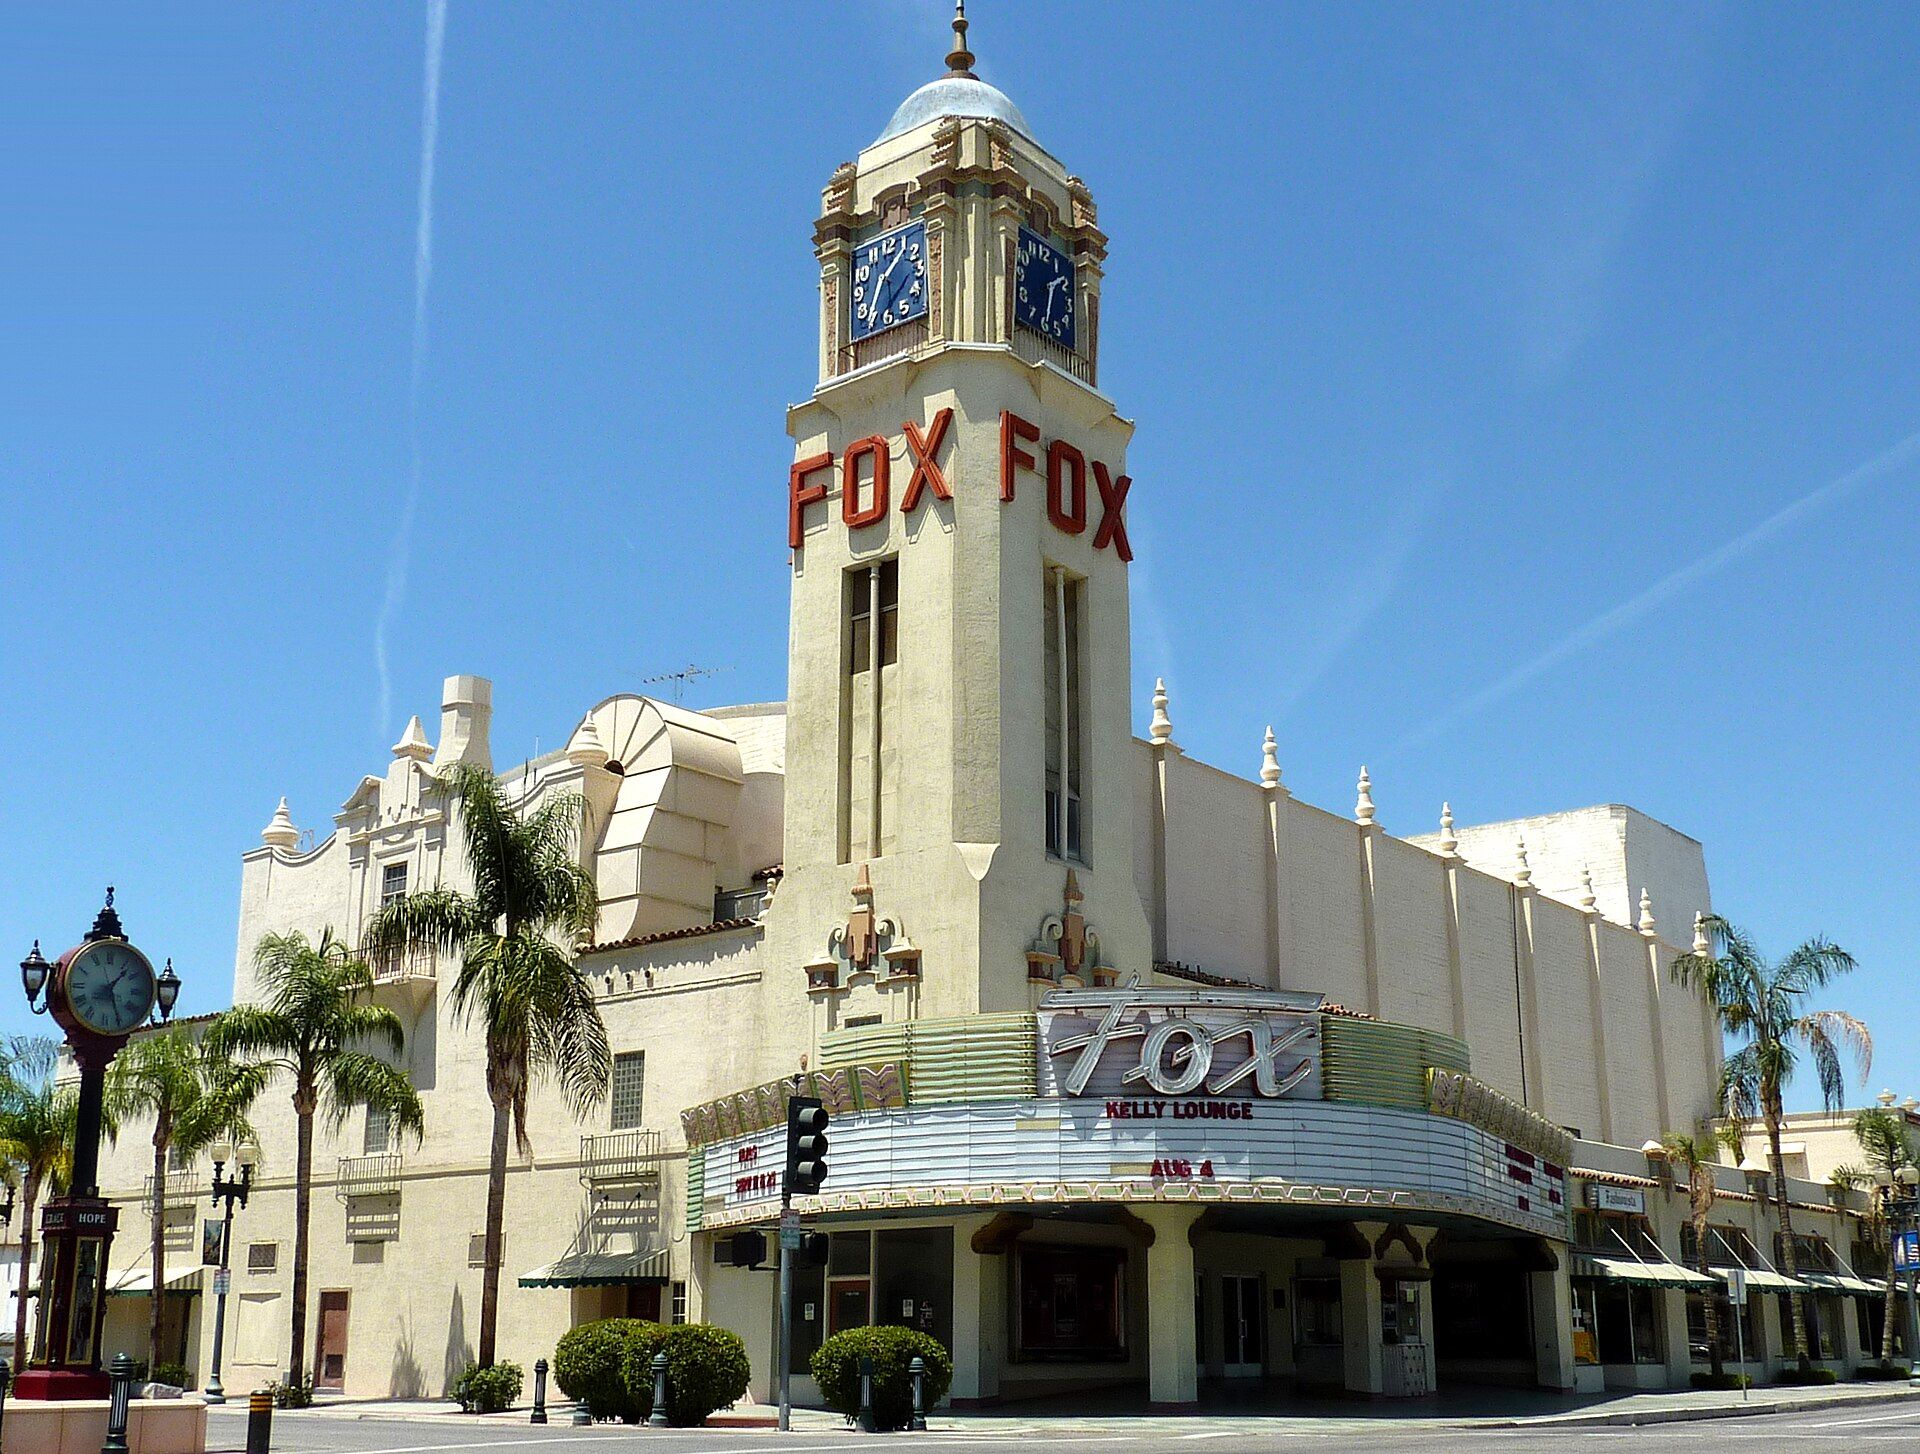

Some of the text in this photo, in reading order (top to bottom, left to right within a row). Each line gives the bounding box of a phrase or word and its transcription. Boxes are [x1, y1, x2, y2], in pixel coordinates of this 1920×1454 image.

[882, 237, 895, 255] 12
[910, 243, 919, 261] 2
[1028, 240, 1036, 257] 11
[1039, 243, 1050, 262] 12
[869, 247, 878, 263] 11
[1018, 247, 1030, 266] 10
[915, 260, 924, 277] 3
[1017, 266, 1025, 281] 9
[1054, 258, 1059, 273] 1
[855, 265, 870, 284] 10
[909, 281, 921, 297] 4
[1062, 278, 1069, 292] 2
[854, 286, 864, 302] 9
[1019, 286, 1028, 303] 8
[857, 303, 868, 319] 8
[899, 299, 910, 315] 5
[1029, 305, 1036, 319] 7
[1065, 296, 1072, 313] 3
[883, 309, 893, 324] 6
[1041, 316, 1049, 332] 6
[1062, 314, 1069, 329] 4
[1053, 320, 1061, 337] 5
[789, 407, 954, 549] FOX
[1000, 409, 1134, 562] FOX
[1106, 1101, 1254, 1120] KELLY LOUNGE
[1150, 1159, 1214, 1178] AUG 4
[78, 1213, 106, 1224] HOPE
